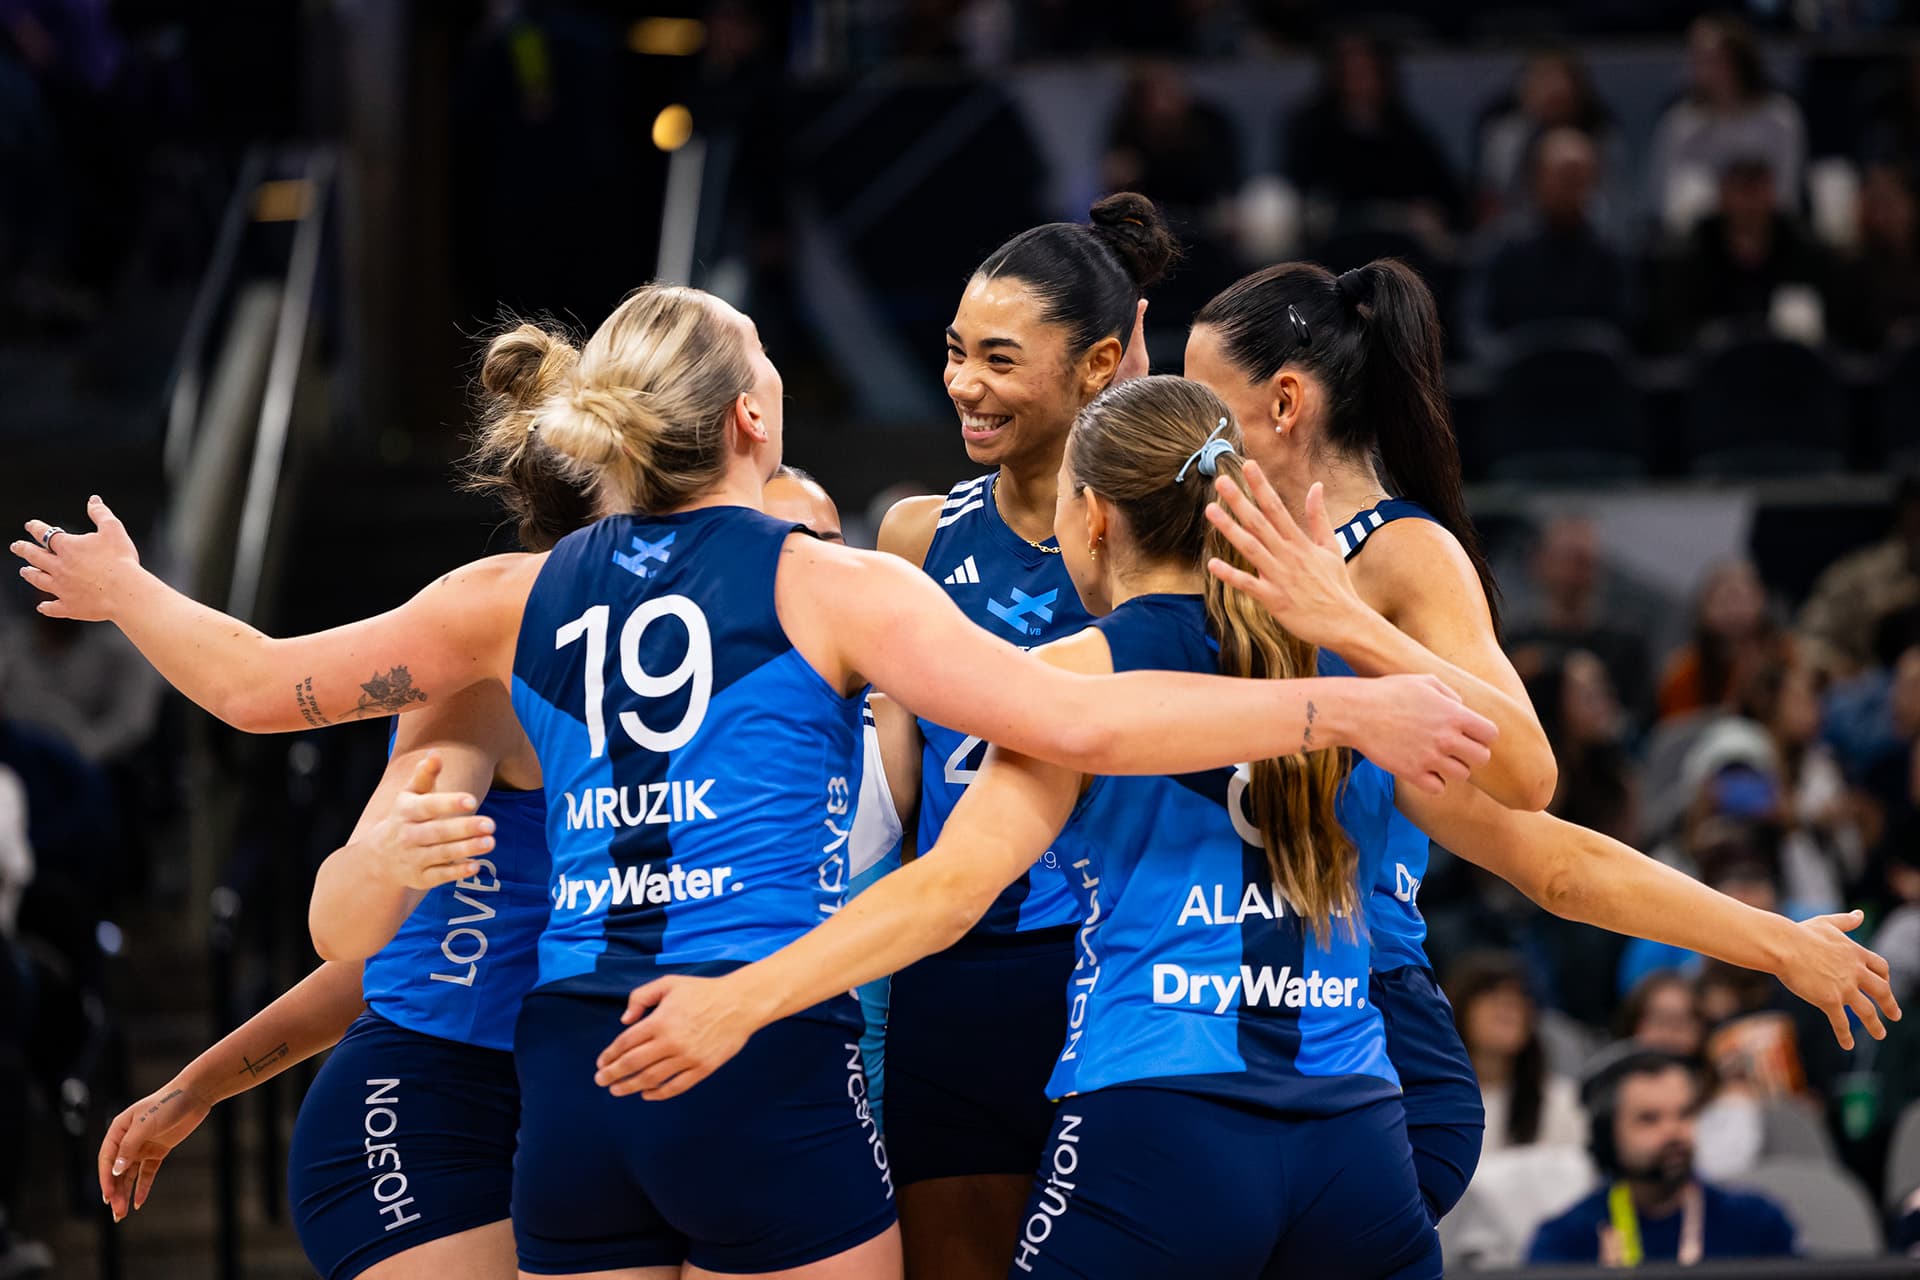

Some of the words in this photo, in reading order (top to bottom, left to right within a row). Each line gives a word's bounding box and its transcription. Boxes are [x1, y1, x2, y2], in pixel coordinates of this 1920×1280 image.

[555, 594, 714, 759] 19
[564, 778, 718, 831] MRUZIK
[818, 776, 849, 914] LOVB
[363, 1078, 422, 1232] HOSTON
[844, 1042, 895, 1201] HOUSON
[1014, 1114, 1083, 1273] HOUTON
